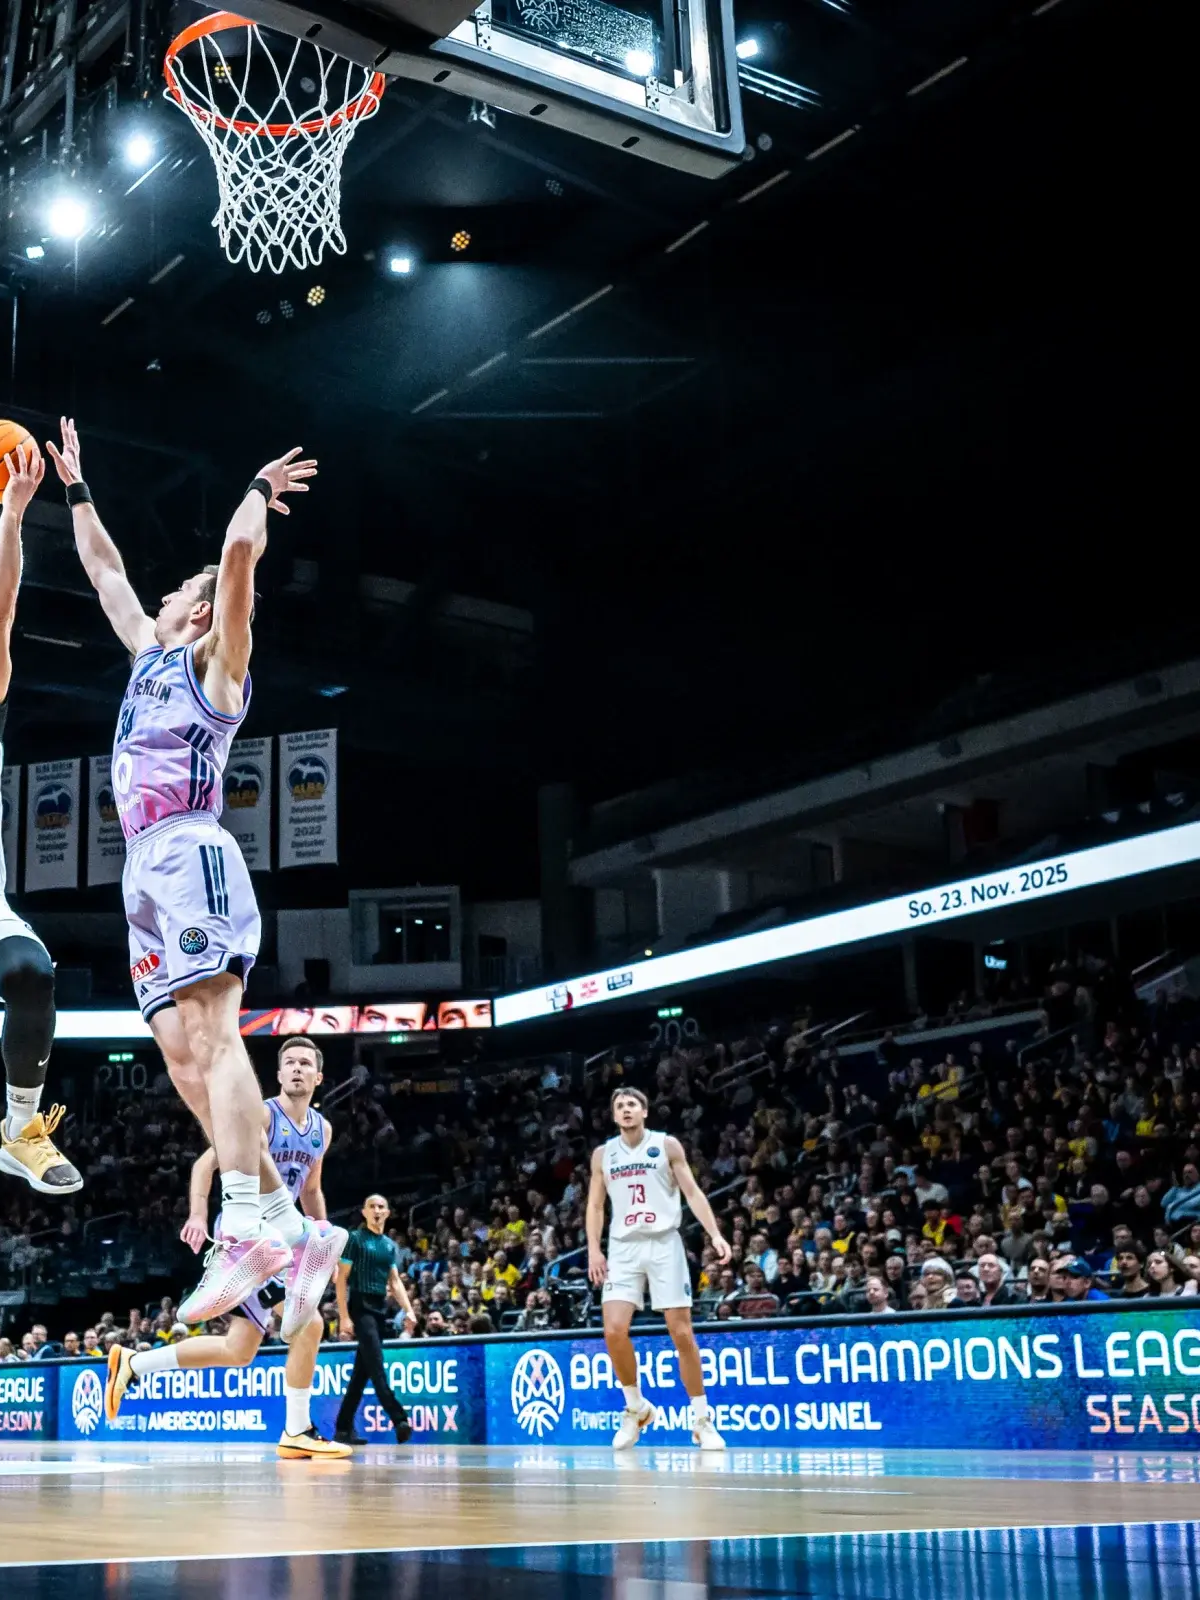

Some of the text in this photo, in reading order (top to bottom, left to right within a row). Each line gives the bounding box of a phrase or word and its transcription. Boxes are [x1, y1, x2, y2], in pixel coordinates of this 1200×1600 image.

[117, 706, 136, 744] 34
[295, 826, 322, 837] 2022
[908, 863, 1068, 918] So. 23. Nov. 2025
[628, 1184, 646, 1206] 73
[625, 1211, 657, 1226] era
[570, 1345, 789, 1389] BAKEBALL
[795, 1333, 1063, 1386] CHAMPIONS
[125, 1369, 221, 1400] SKETBALL
[33, 1411, 44, 1431] X
[148, 1411, 217, 1431] AMERESCO
[222, 1409, 267, 1431] SUNEL
[442, 1405, 459, 1432] X
[795, 1401, 882, 1431] SUNEL
[1086, 1394, 1200, 1433] SEAS
